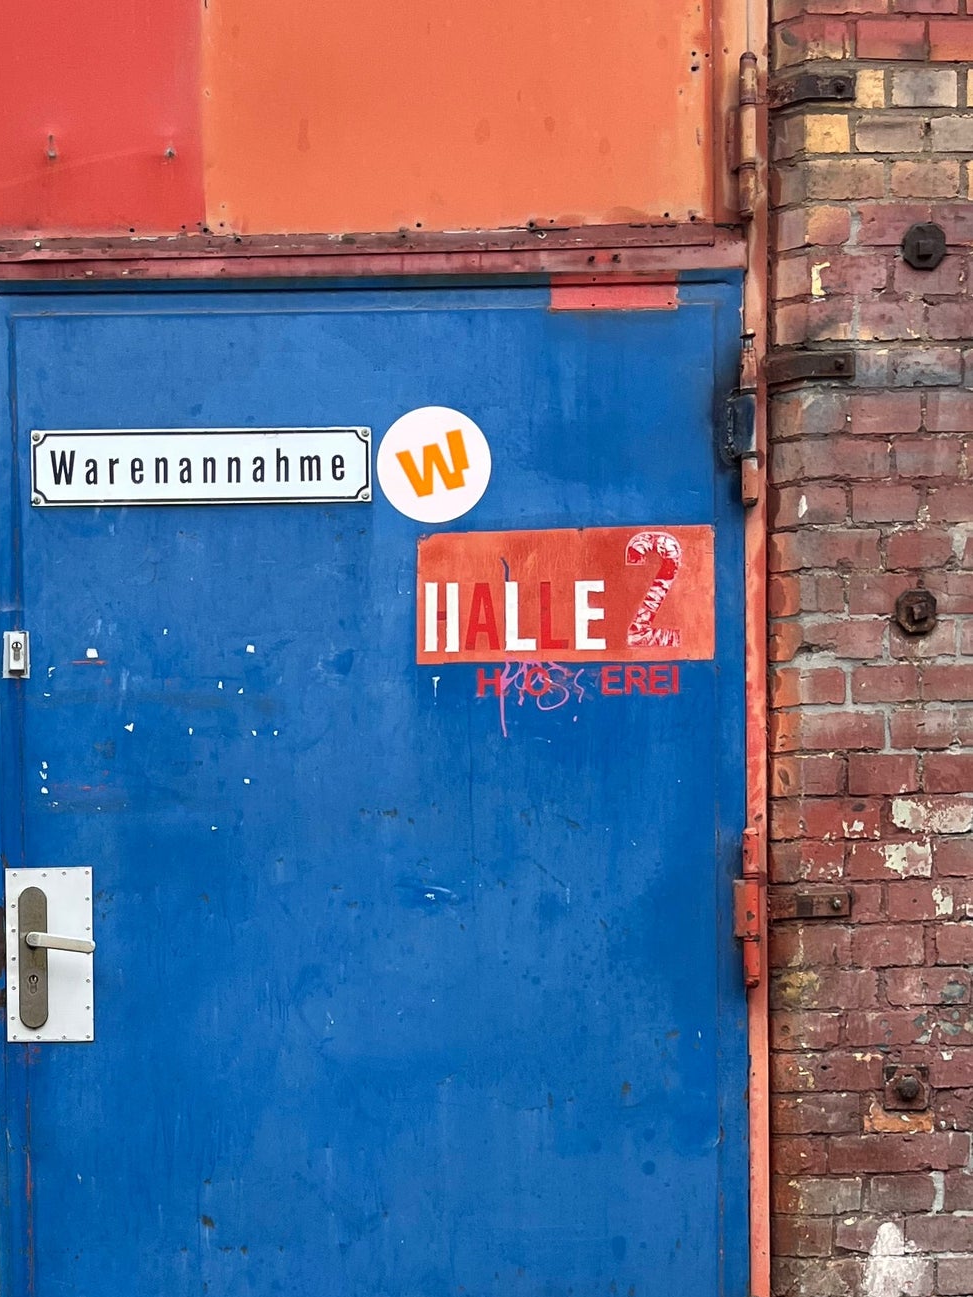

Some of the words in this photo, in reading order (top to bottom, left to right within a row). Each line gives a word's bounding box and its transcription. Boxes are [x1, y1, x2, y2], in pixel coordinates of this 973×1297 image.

[49, 445, 347, 487] Warenannahme
[395, 429, 470, 498] W
[424, 580, 607, 652] HALLE
[625, 531, 682, 648] 2
